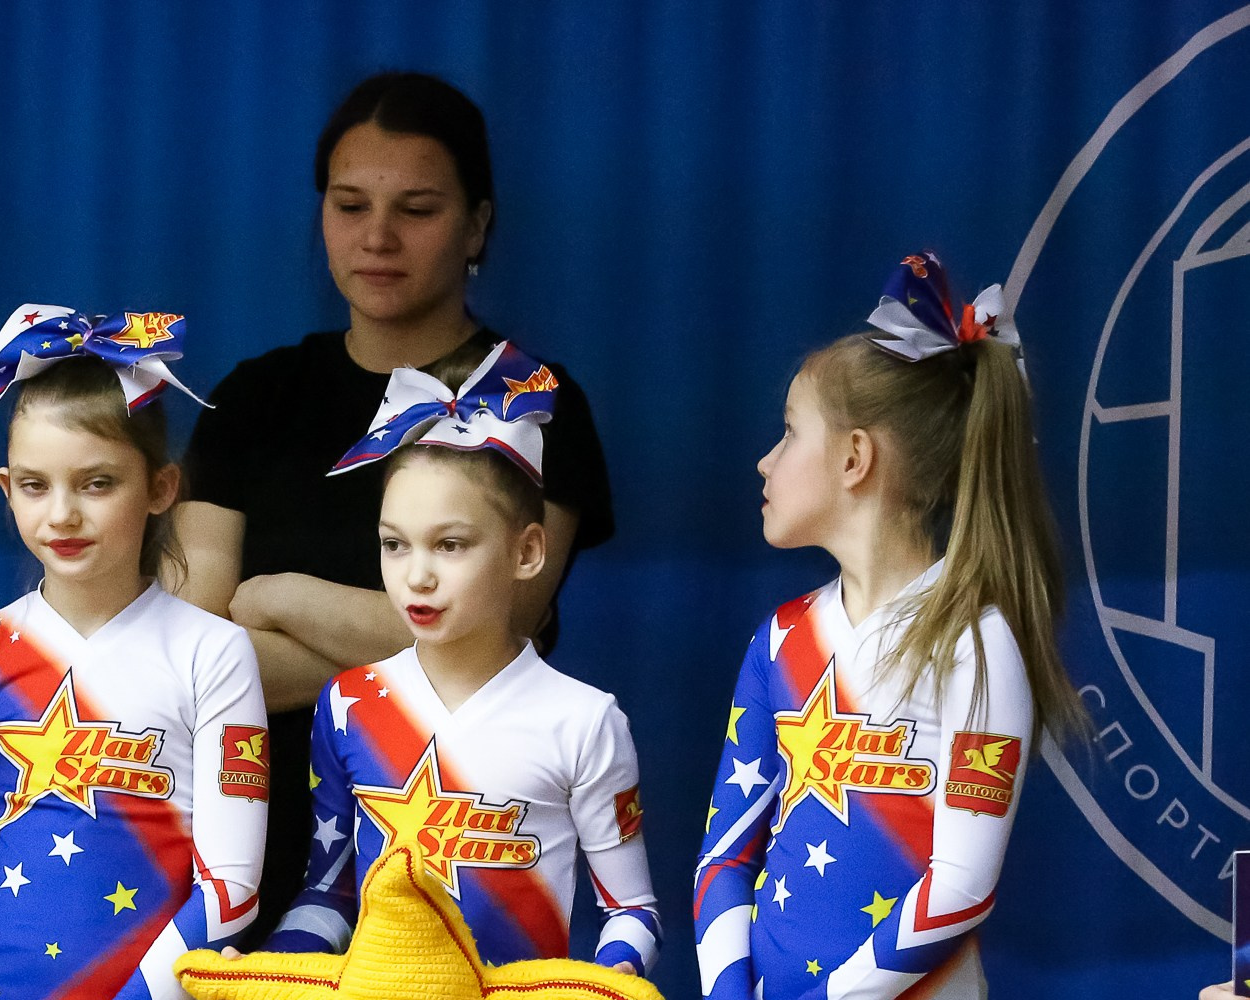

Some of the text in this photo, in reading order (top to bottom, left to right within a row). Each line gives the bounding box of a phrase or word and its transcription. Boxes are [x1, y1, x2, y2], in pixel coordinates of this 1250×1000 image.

[60, 729, 154, 760] Zlat
[816, 721, 905, 754] Zlat
[49, 756, 168, 793] Stars
[804, 749, 927, 787] Stars
[423, 799, 518, 831] Zlat
[417, 827, 532, 861] Stars
